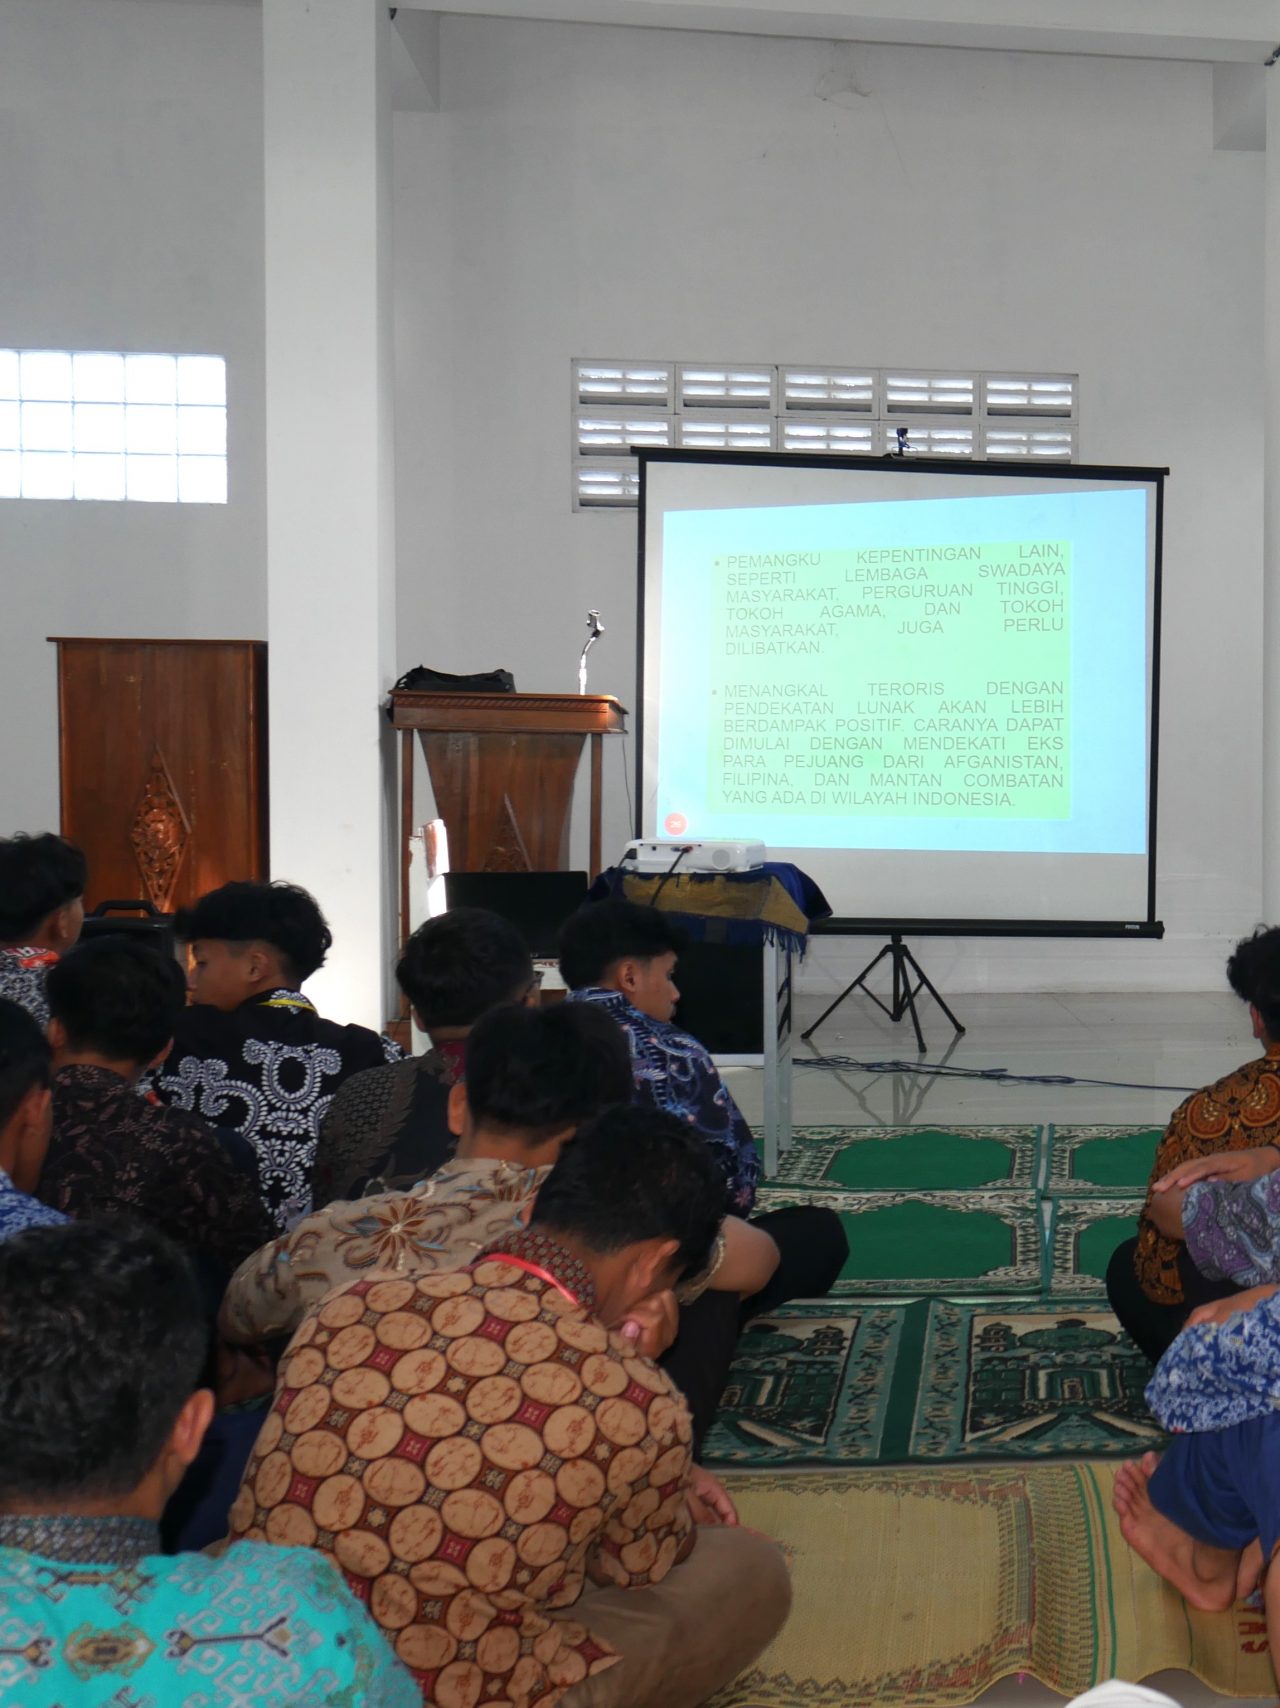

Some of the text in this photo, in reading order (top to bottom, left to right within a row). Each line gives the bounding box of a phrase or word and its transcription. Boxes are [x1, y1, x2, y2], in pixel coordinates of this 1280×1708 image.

[727, 552, 821, 568] PEMANGKU
[857, 547, 981, 564] KEPENTINGAN
[727, 563, 1065, 585] SEPERTI LEMBAGA SWADAYA
[862, 584, 973, 599] PERGURUAN
[727, 607, 783, 620] TOKOH
[925, 602, 961, 616] DAN
[1001, 599, 1064, 614] TOKOH
[898, 621, 943, 635] JUGA
[1004, 618, 1064, 632] PERLU
[724, 681, 1064, 698] MENANGKAL TERORIS DENGAN
[724, 700, 1063, 715] PENDEKATAN LUNAK AKAN LEBIH
[723, 719, 825, 733] BERDAMPAK
[914, 718, 998, 732] CARANYA
[1006, 718, 1064, 732] DAPAT
[723, 737, 790, 751] DIMULAI
[810, 736, 882, 750] DENGAN
[1028, 736, 1063, 750] EKS
[723, 755, 766, 768] PARA
[784, 755, 864, 769] PEJUANG
[883, 755, 924, 768] DARI
[815, 773, 849, 786] DAN
[870, 773, 942, 787] MANTAN
[964, 773, 1063, 787] COMBATAN
[722, 791, 767, 804] YANG
[772, 791, 805, 804] ADA
[811, 791, 826, 804] DI
[831, 791, 907, 805] WILAYAH
